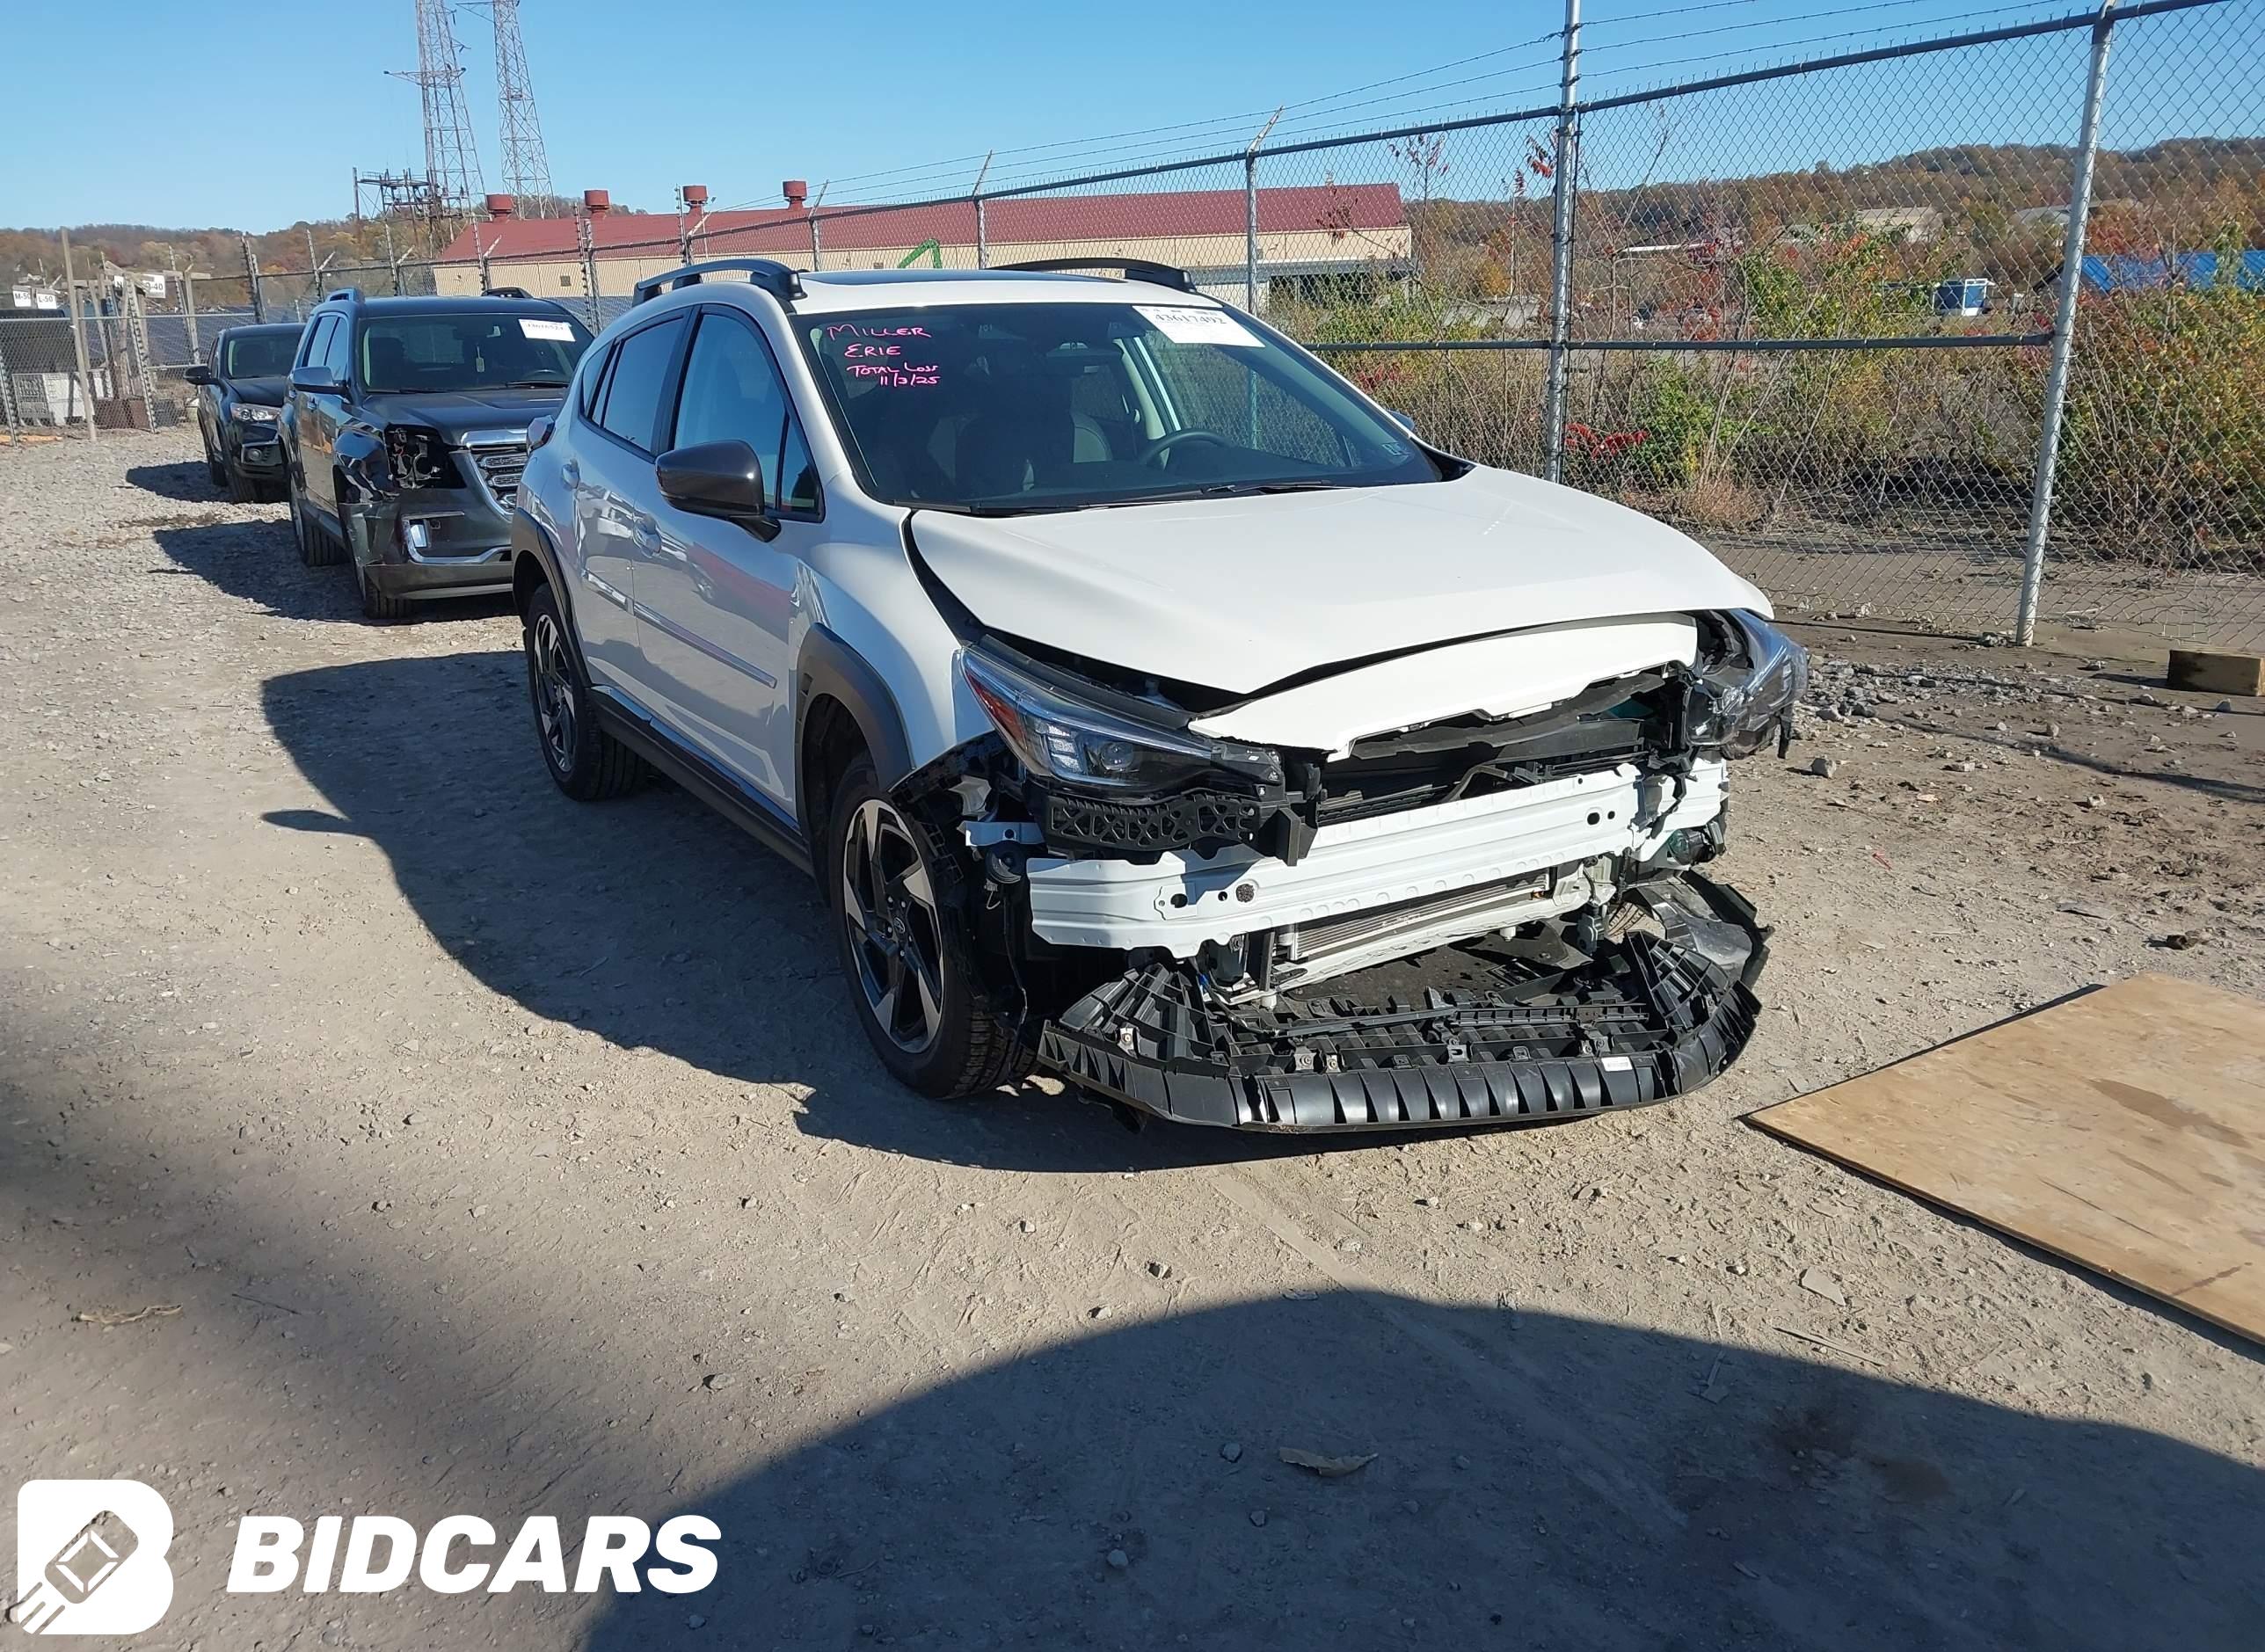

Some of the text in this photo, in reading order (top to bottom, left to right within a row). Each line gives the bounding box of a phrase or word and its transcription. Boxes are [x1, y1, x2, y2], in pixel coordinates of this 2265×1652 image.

[827, 324, 932, 341] MILLER
[844, 343, 901, 358] ERIE
[880, 372, 942, 387] 11/3/25
